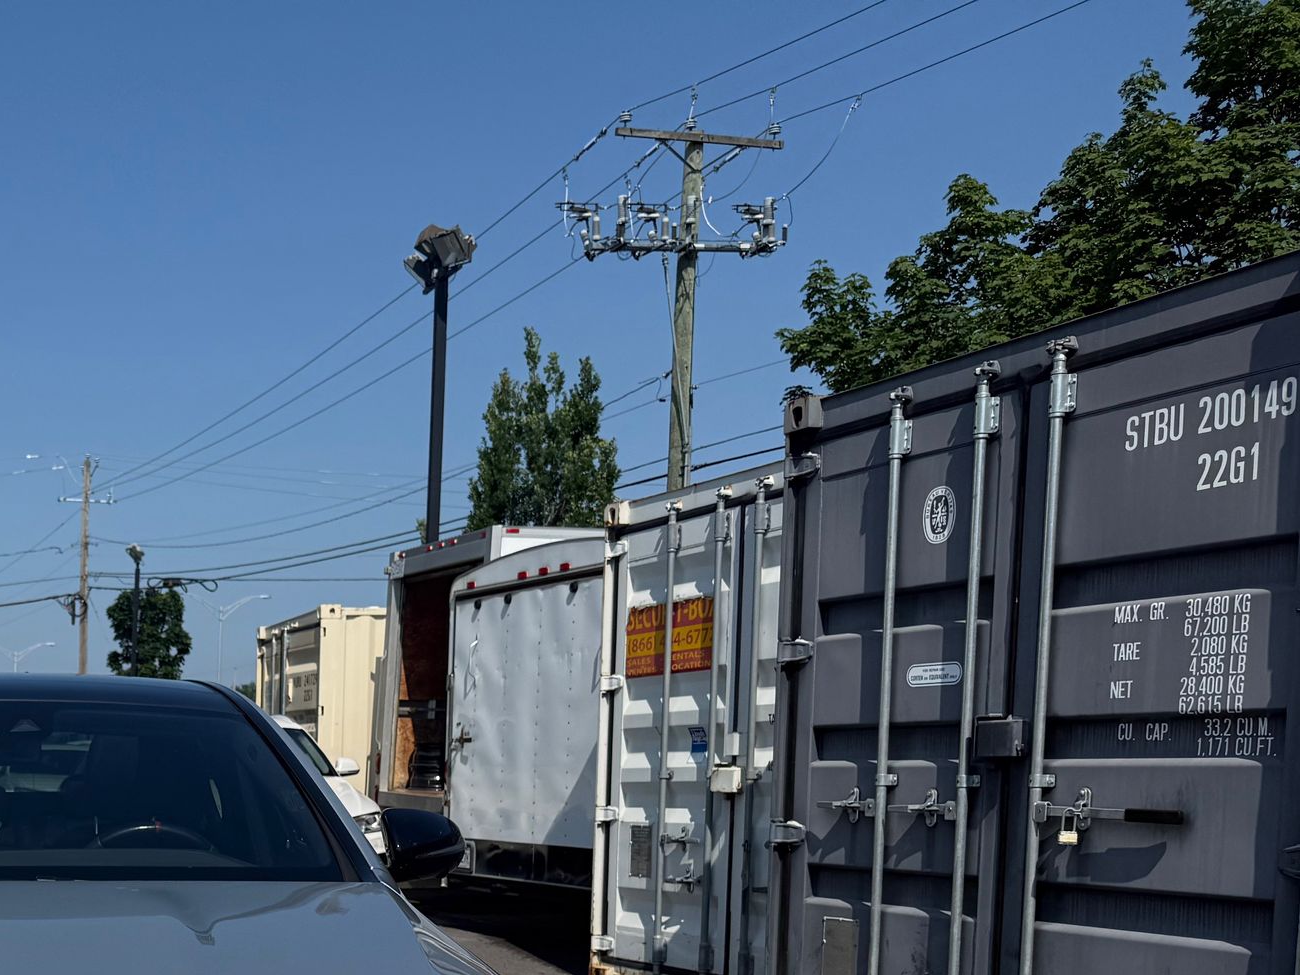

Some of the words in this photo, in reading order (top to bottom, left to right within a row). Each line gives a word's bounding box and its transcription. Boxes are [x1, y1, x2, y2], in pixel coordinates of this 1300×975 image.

[1125, 402, 1185, 452] STBU
[1197, 376, 1298, 435] 200149
[1196, 441, 1260, 492] 22G1
[1113, 604, 1143, 625] MAX.
[1149, 601, 1170, 621] GR.
[1185, 595, 1230, 618] 30,480
[1233, 593, 1252, 614] KG
[1184, 615, 1229, 638] 67,200
[1232, 614, 1250, 634] LB
[1112, 642, 1142, 662] TARE
[1190, 636, 1227, 657] 2,080
[1230, 634, 1249, 654] KG
[671, 660, 711, 671] OCATION
[1188, 655, 1225, 677] 4,585
[1229, 654, 1247, 674] LB
[1109, 680, 1133, 699] NET
[1179, 676, 1224, 697] 28,400
[1227, 675, 1245, 695] KG
[1178, 695, 1223, 716] 62,615
[1226, 694, 1243, 714] LB
[1117, 723, 1136, 741] CU.
[1145, 722, 1172, 742] CAP.
[1204, 718, 1232, 738] 33.2
[1236, 717, 1272, 737] CU.M.
[1197, 737, 1229, 758] 1,171
[1235, 736, 1277, 757] CU.FT.
